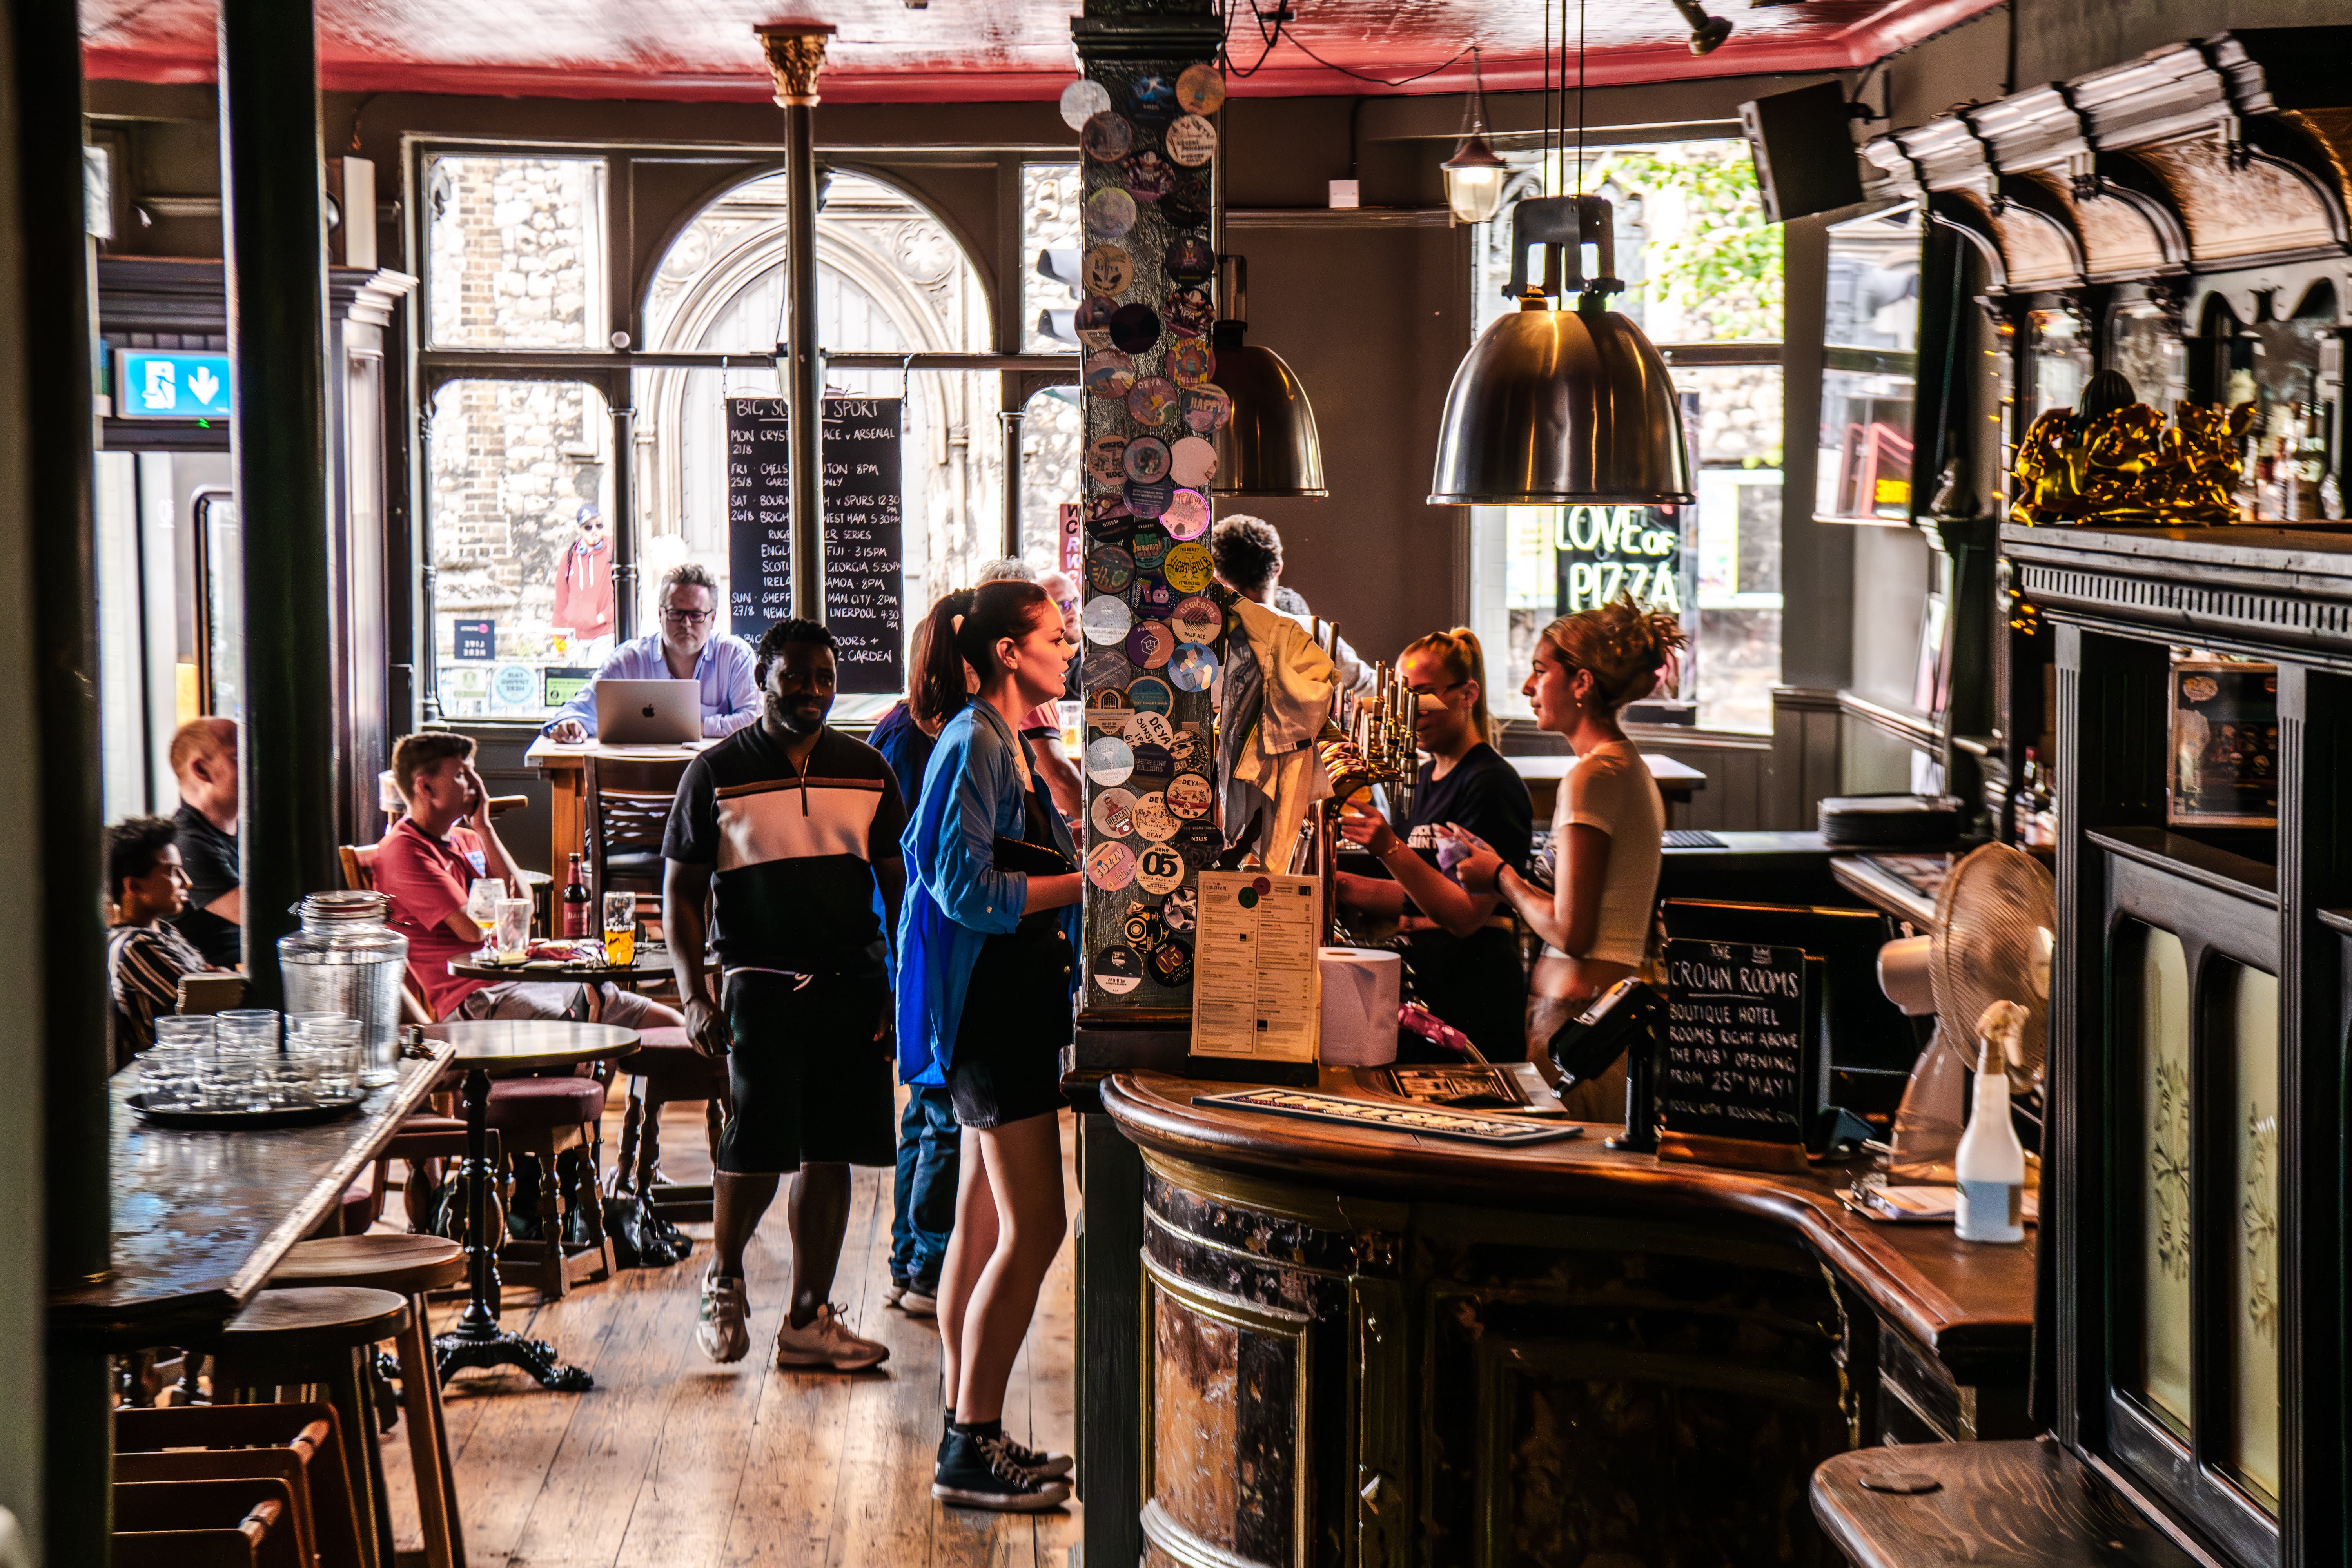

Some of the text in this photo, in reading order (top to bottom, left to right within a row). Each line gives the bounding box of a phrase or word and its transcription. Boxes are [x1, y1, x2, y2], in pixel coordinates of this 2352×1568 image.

[736, 399, 764, 416] BIG
[834, 399, 879, 418] SPORT
[731, 429, 754, 442] MON
[853, 428, 895, 441] ARSENAL
[732, 444, 753, 455] 21/8
[731, 463, 748, 475] FRI
[856, 464, 879, 476] 8PM
[731, 477, 752, 487] 25/8
[730, 495, 747, 507] SAT
[844, 495, 875, 506] SPURS
[731, 510, 754, 521] 26/8
[847, 512, 867, 524] HAM
[843, 530, 871, 540] SERIES
[1555, 505, 1676, 555] LOVE OF
[827, 546, 844, 557] FIJI
[827, 561, 869, 573] GEORGIA
[1190, 556, 1213, 575] BULB
[862, 578, 885, 590] 8PM
[1570, 561, 1681, 614] PIZZA
[731, 592, 751, 604] SUN
[828, 593, 848, 604] MAN
[851, 594, 870, 606] CITY
[877, 595, 898, 606] 2PM
[732, 605, 755, 616] 27/8
[886, 621, 898, 631] PM
[848, 650, 892, 664] GARDEN
[1149, 716, 1171, 745] DEYA
[1107, 808, 1129, 825] HEPCAT
[1093, 847, 1125, 879] FUZZY
[1142, 851, 1179, 878] 05
[1671, 961, 1799, 998] CROWN ROOMS
[1670, 1002, 1780, 1026] BOUTIQUE HOTEL
[1669, 1025, 1716, 1045] ROOMS
